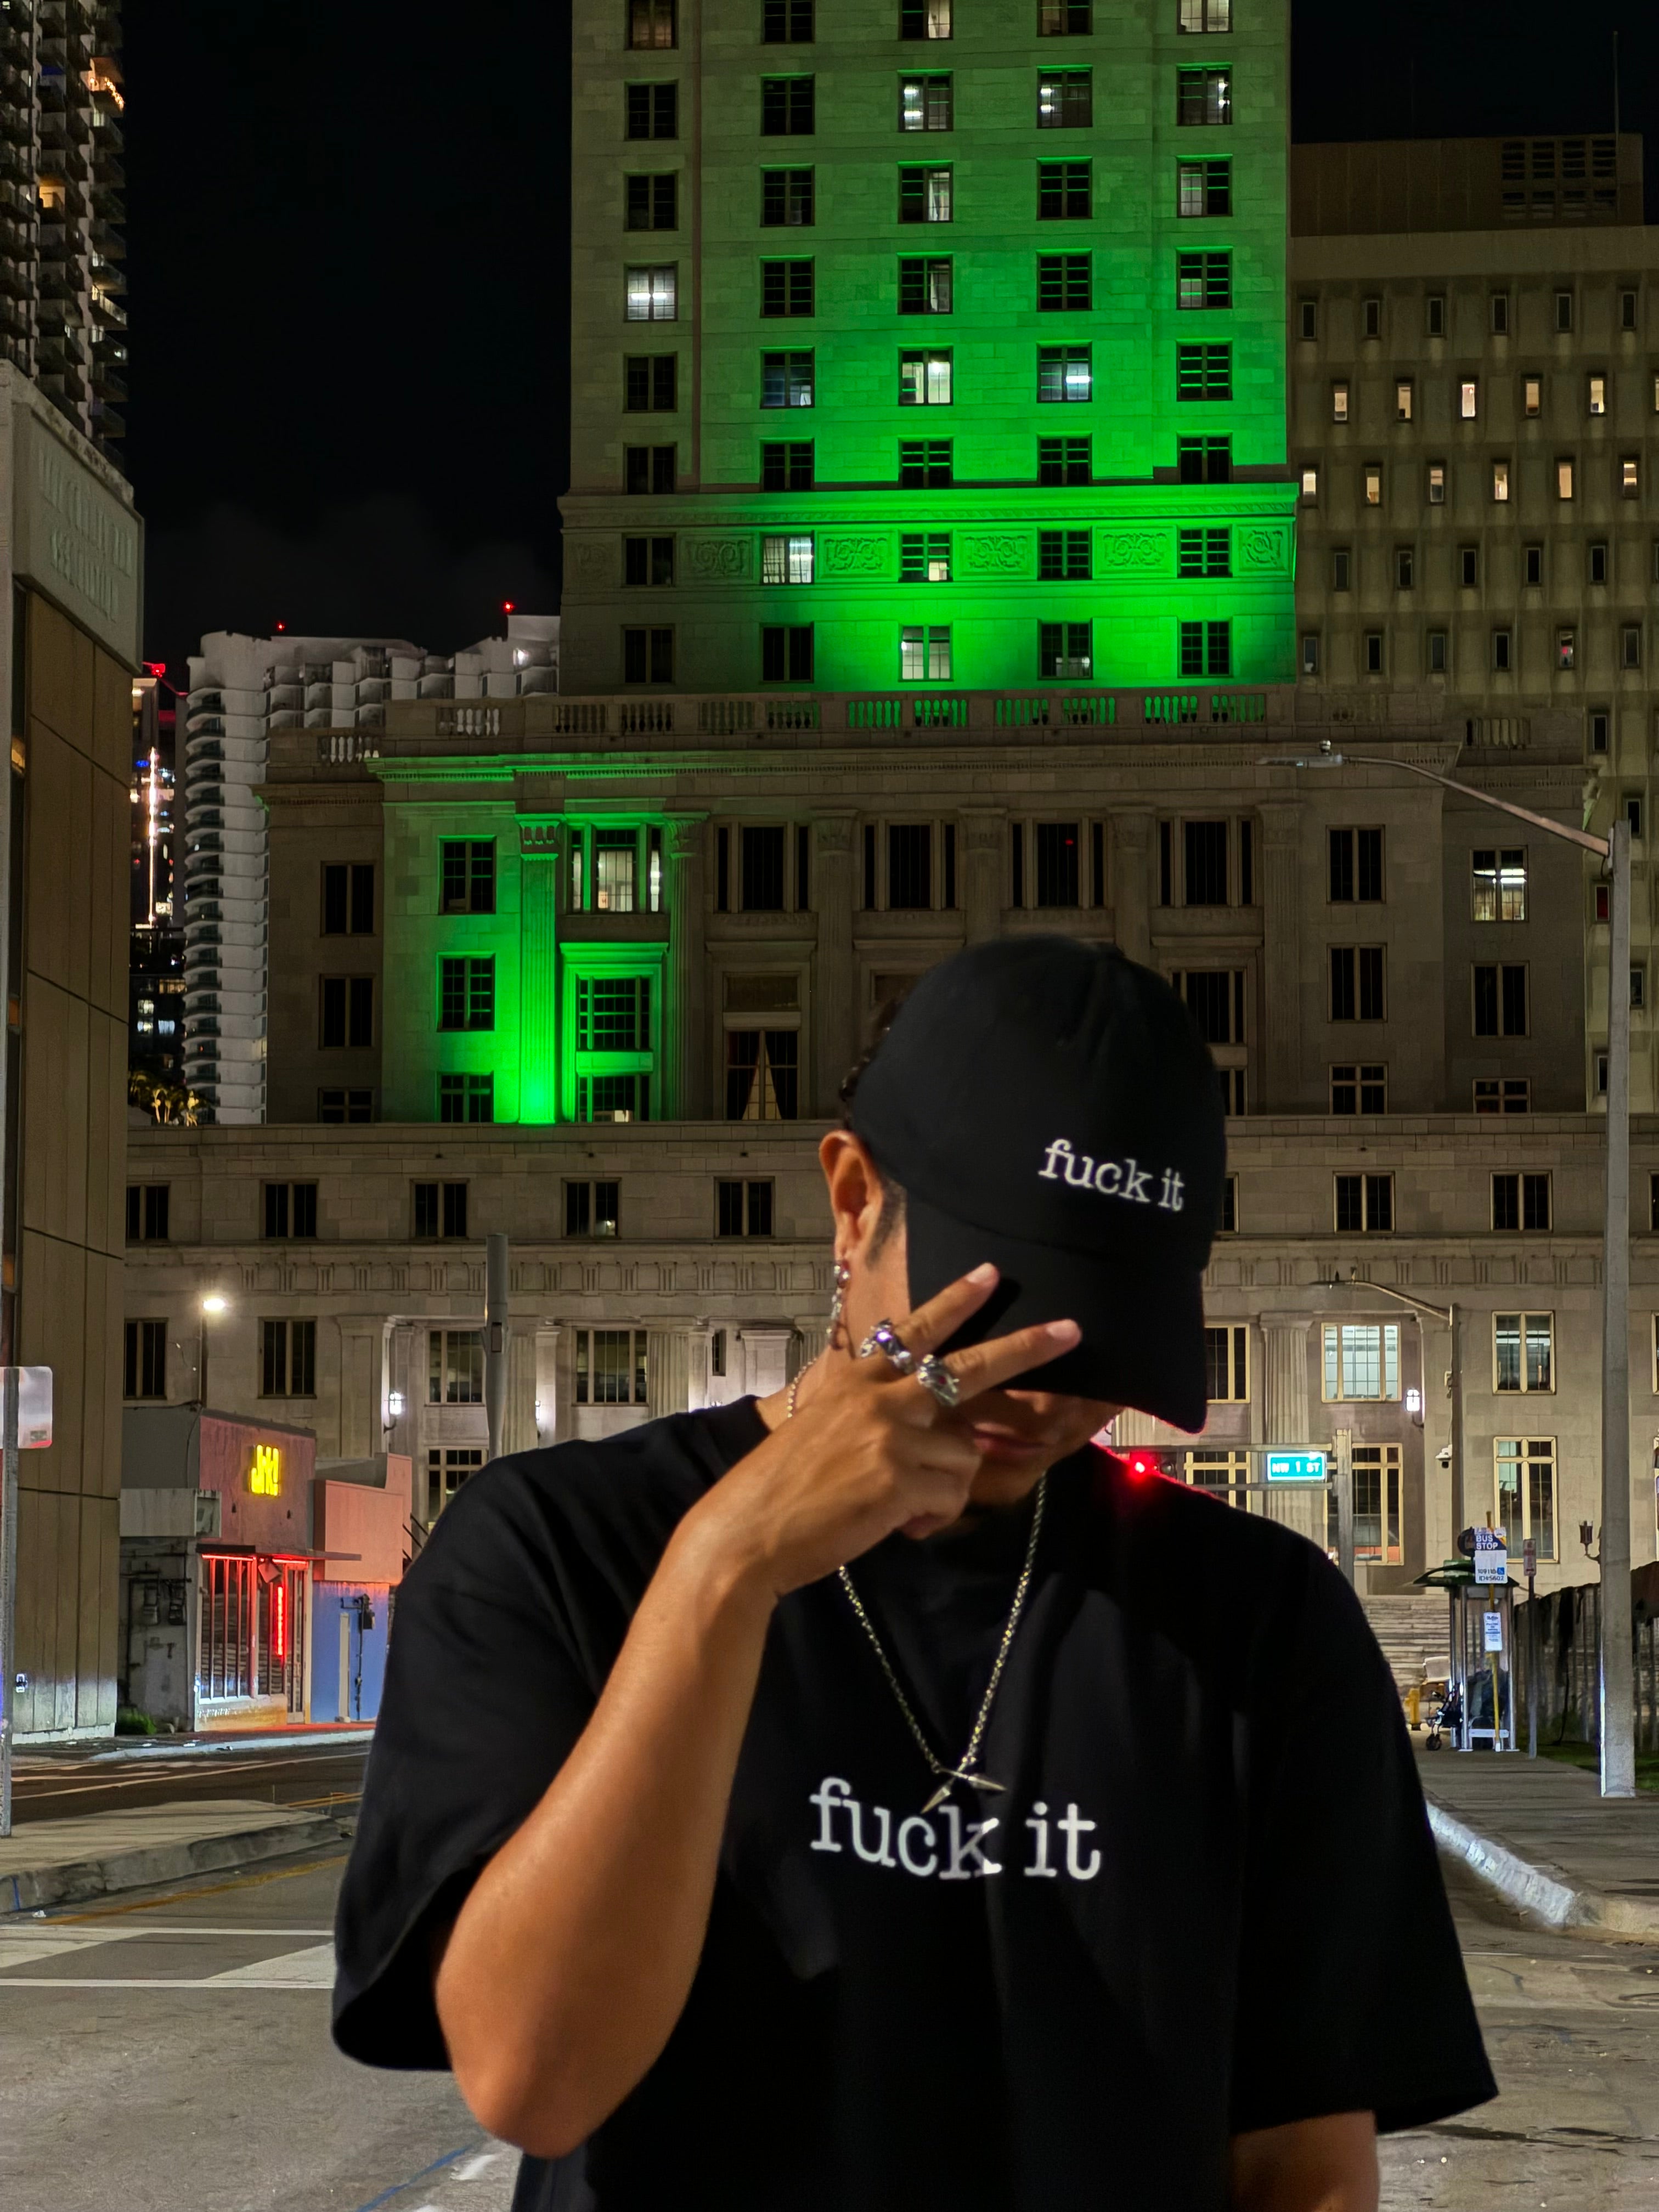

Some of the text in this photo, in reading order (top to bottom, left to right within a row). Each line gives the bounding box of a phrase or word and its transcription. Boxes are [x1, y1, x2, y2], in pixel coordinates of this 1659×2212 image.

[1038, 1139, 1185, 1211] fuck it
[1272, 1460, 1321, 1473] NW 1 ST
[809, 1776, 1102, 1880] fuck it
